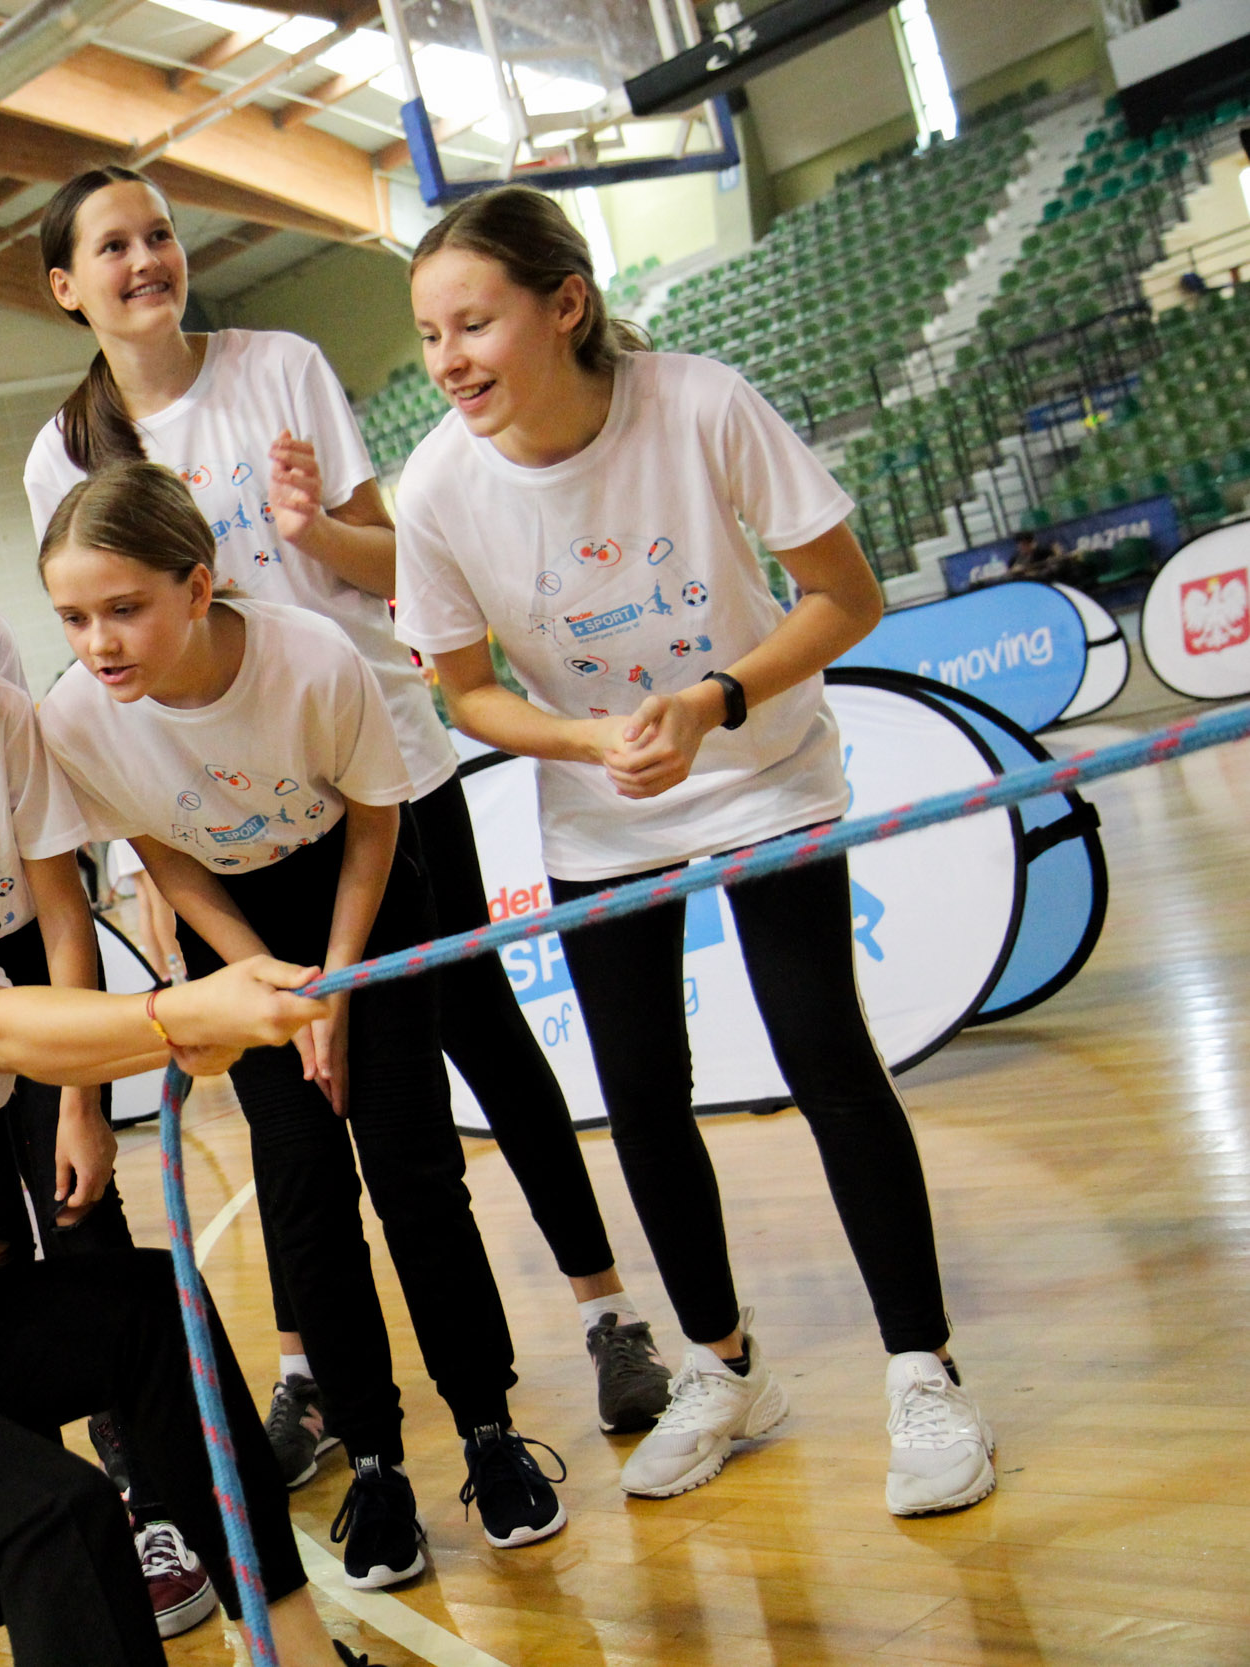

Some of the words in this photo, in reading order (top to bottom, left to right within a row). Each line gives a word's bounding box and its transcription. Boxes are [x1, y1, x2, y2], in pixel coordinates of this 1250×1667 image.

[938, 626, 1054, 689] moving
[488, 882, 544, 924] der
[543, 1002, 573, 1048] of
